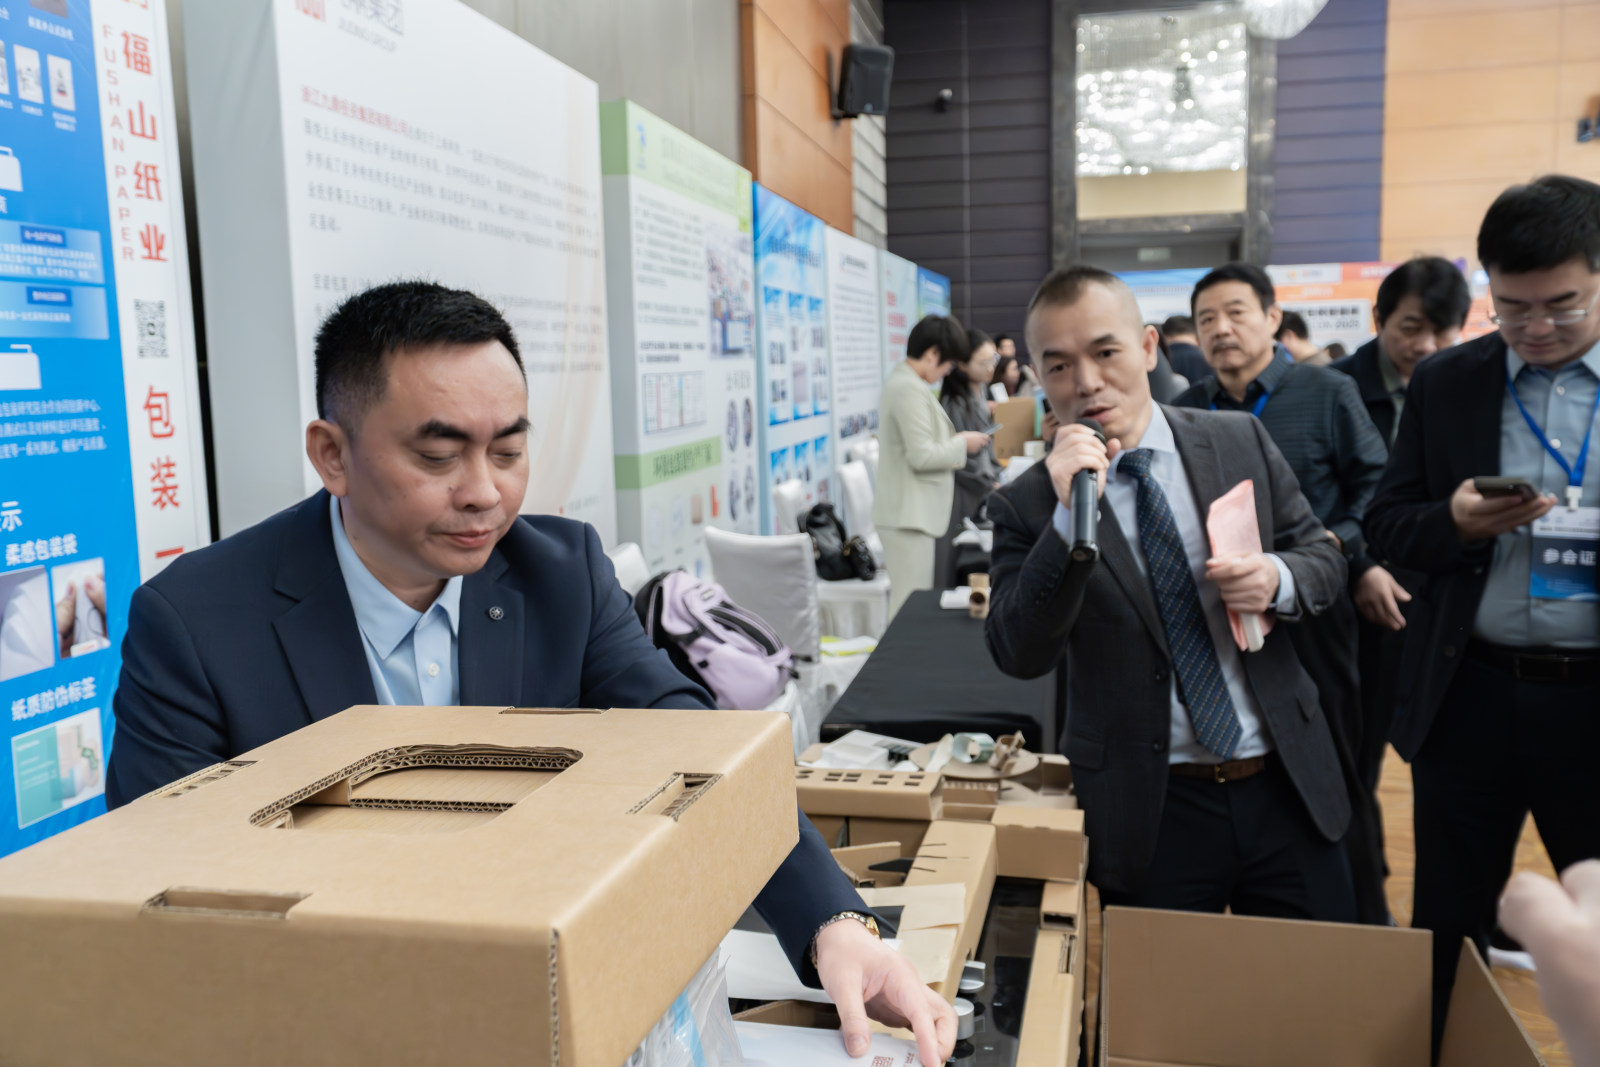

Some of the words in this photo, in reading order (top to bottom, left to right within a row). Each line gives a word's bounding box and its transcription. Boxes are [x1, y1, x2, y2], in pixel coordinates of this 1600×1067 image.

[121, 30, 168, 262] 福山纸业
[115, 164, 135, 261] PAPER
[0, 500, 23, 532] 示
